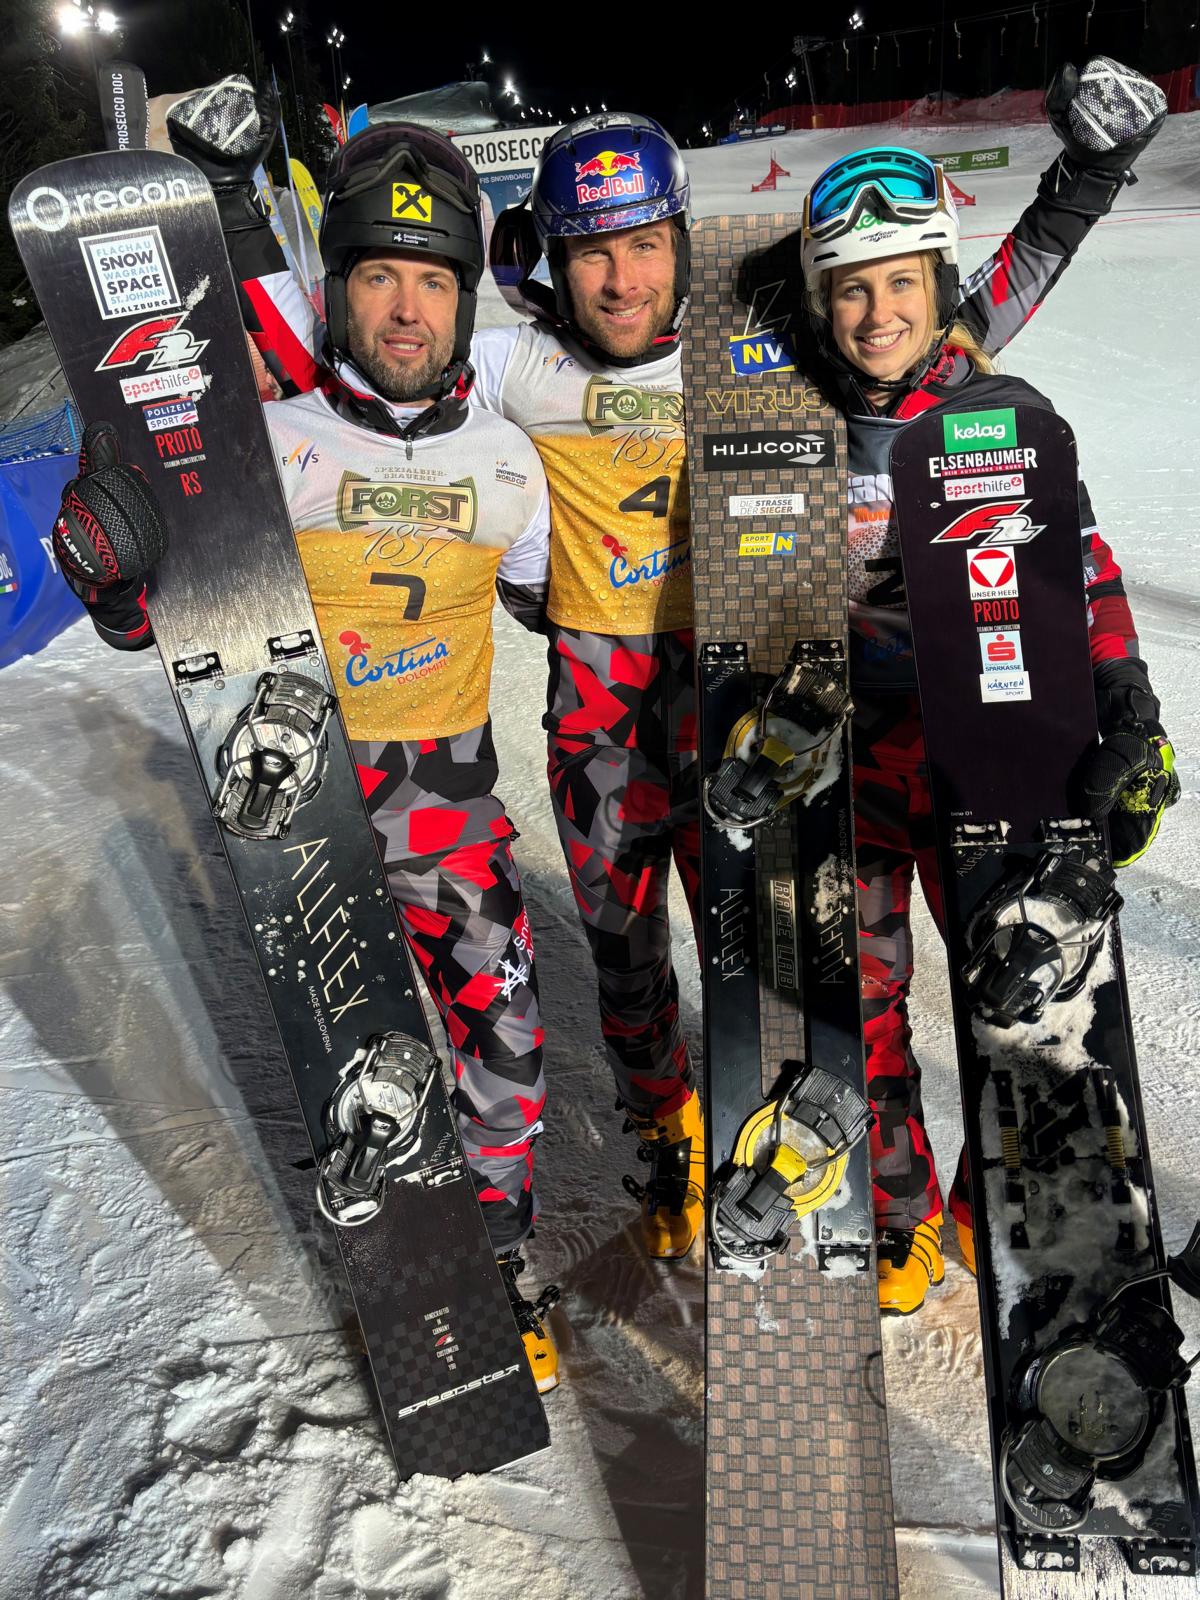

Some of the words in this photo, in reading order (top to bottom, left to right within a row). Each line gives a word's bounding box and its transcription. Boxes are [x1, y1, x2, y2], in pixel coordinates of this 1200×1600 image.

[112, 73, 123, 95] DOC
[113, 97, 130, 150] PROSECCO
[972, 152, 1001, 162] FORST
[491, 172, 532, 183] SNOWBOARD
[576, 178, 611, 204] Red
[611, 173, 645, 196] Bull
[76, 177, 191, 216] recon
[96, 241, 152, 257] FLACHAU
[100, 250, 154, 271] SNOW
[103, 264, 159, 281] WAGRAIN
[107, 274, 163, 295] SPACE
[111, 296, 125, 305] ST.
[126, 288, 165, 303] JOHANN
[114, 299, 169, 315] SALZBURG
[123, 375, 191, 398] sporthilfe
[147, 405, 187, 418] POLIZEI
[595, 389, 685, 422] FORS
[705, 388, 830, 414] VIRUS
[150, 416, 180, 428] SPORT
[954, 423, 1006, 440] kelag
[155, 427, 203, 458] PROTO
[611, 427, 686, 469] 1857
[928, 447, 1038, 478] ELSENBAUMER
[180, 471, 202, 496] RS
[495, 474, 516, 484] WORLD
[946, 482, 1012, 498] sporthilfe
[350, 486, 469, 523] FORST
[618, 475, 671, 518] 4
[755, 499, 793, 507] STRASSE
[740, 507, 759, 515] DER
[364, 524, 458, 569] 1857
[610, 538, 692, 588] Cortin
[370, 572, 426, 621] 7
[973, 599, 1020, 623] PROTO
[345, 637, 450, 687] Cortina
[396, 659, 448, 686] DOLOMITI
[985, 664, 1022, 672] SPARKASSE
[773, 880, 794, 940] RACE
[283, 837, 369, 1023] ALLFLEX
[720, 888, 745, 982] ALLFLEX
[776, 944, 796, 989] LAB
[307, 985, 320, 1009] MADE
[317, 1016, 333, 1053] SLOVENIA
